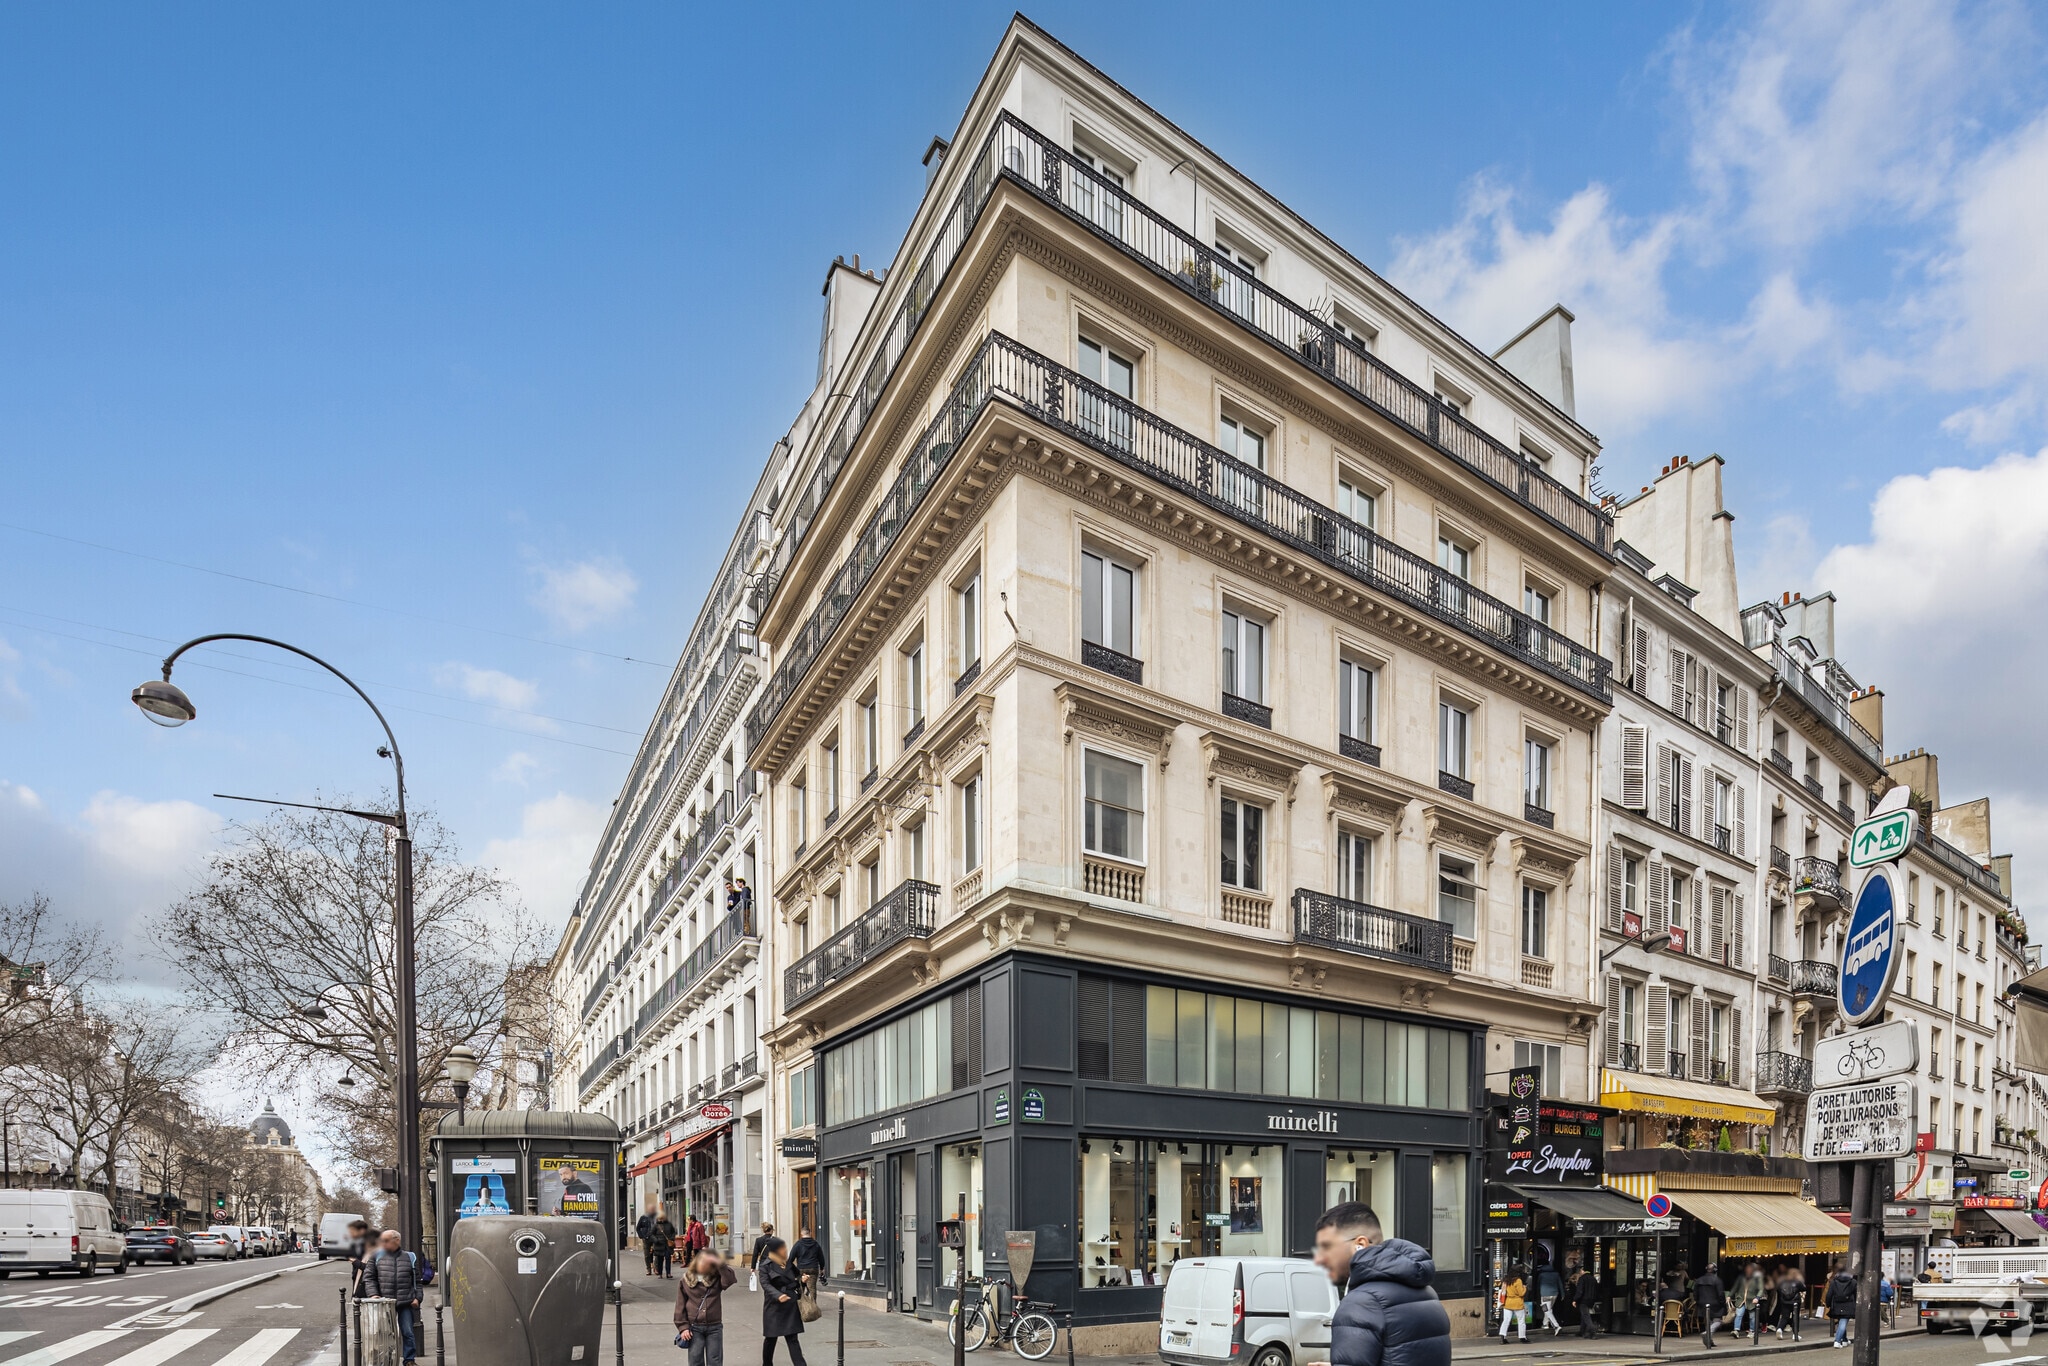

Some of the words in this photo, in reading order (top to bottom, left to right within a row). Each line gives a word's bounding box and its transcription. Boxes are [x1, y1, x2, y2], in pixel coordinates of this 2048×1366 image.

[1817, 1093, 1847, 1110] ARRET
[1849, 1086, 1897, 1106] AUTORISE
[1818, 1109, 1842, 1125] POUR
[1844, 1103, 1898, 1123] LIVRAISONS
[1267, 1109, 1339, 1134] minelli
[870, 1117, 907, 1146] minelli
[1554, 1123, 1581, 1136] BURGER
[1585, 1126, 1602, 1137] PIZZA
[1823, 1126, 1833, 1140] DE
[784, 1143, 814, 1153] minelli
[1813, 1142, 1824, 1156] ET
[1511, 1150, 1532, 1160] OPEN
[543, 1160, 599, 1170] ENTREVUE
[1532, 1144, 1593, 1182] Simplon
[577, 1192, 598, 1203] CYRIL
[1965, 1197, 1985, 1207] BAR
[563, 1202, 599, 1212] HANOUNA
[576, 1234, 595, 1244] D389
[0, 1296, 168, 1308] BUS
